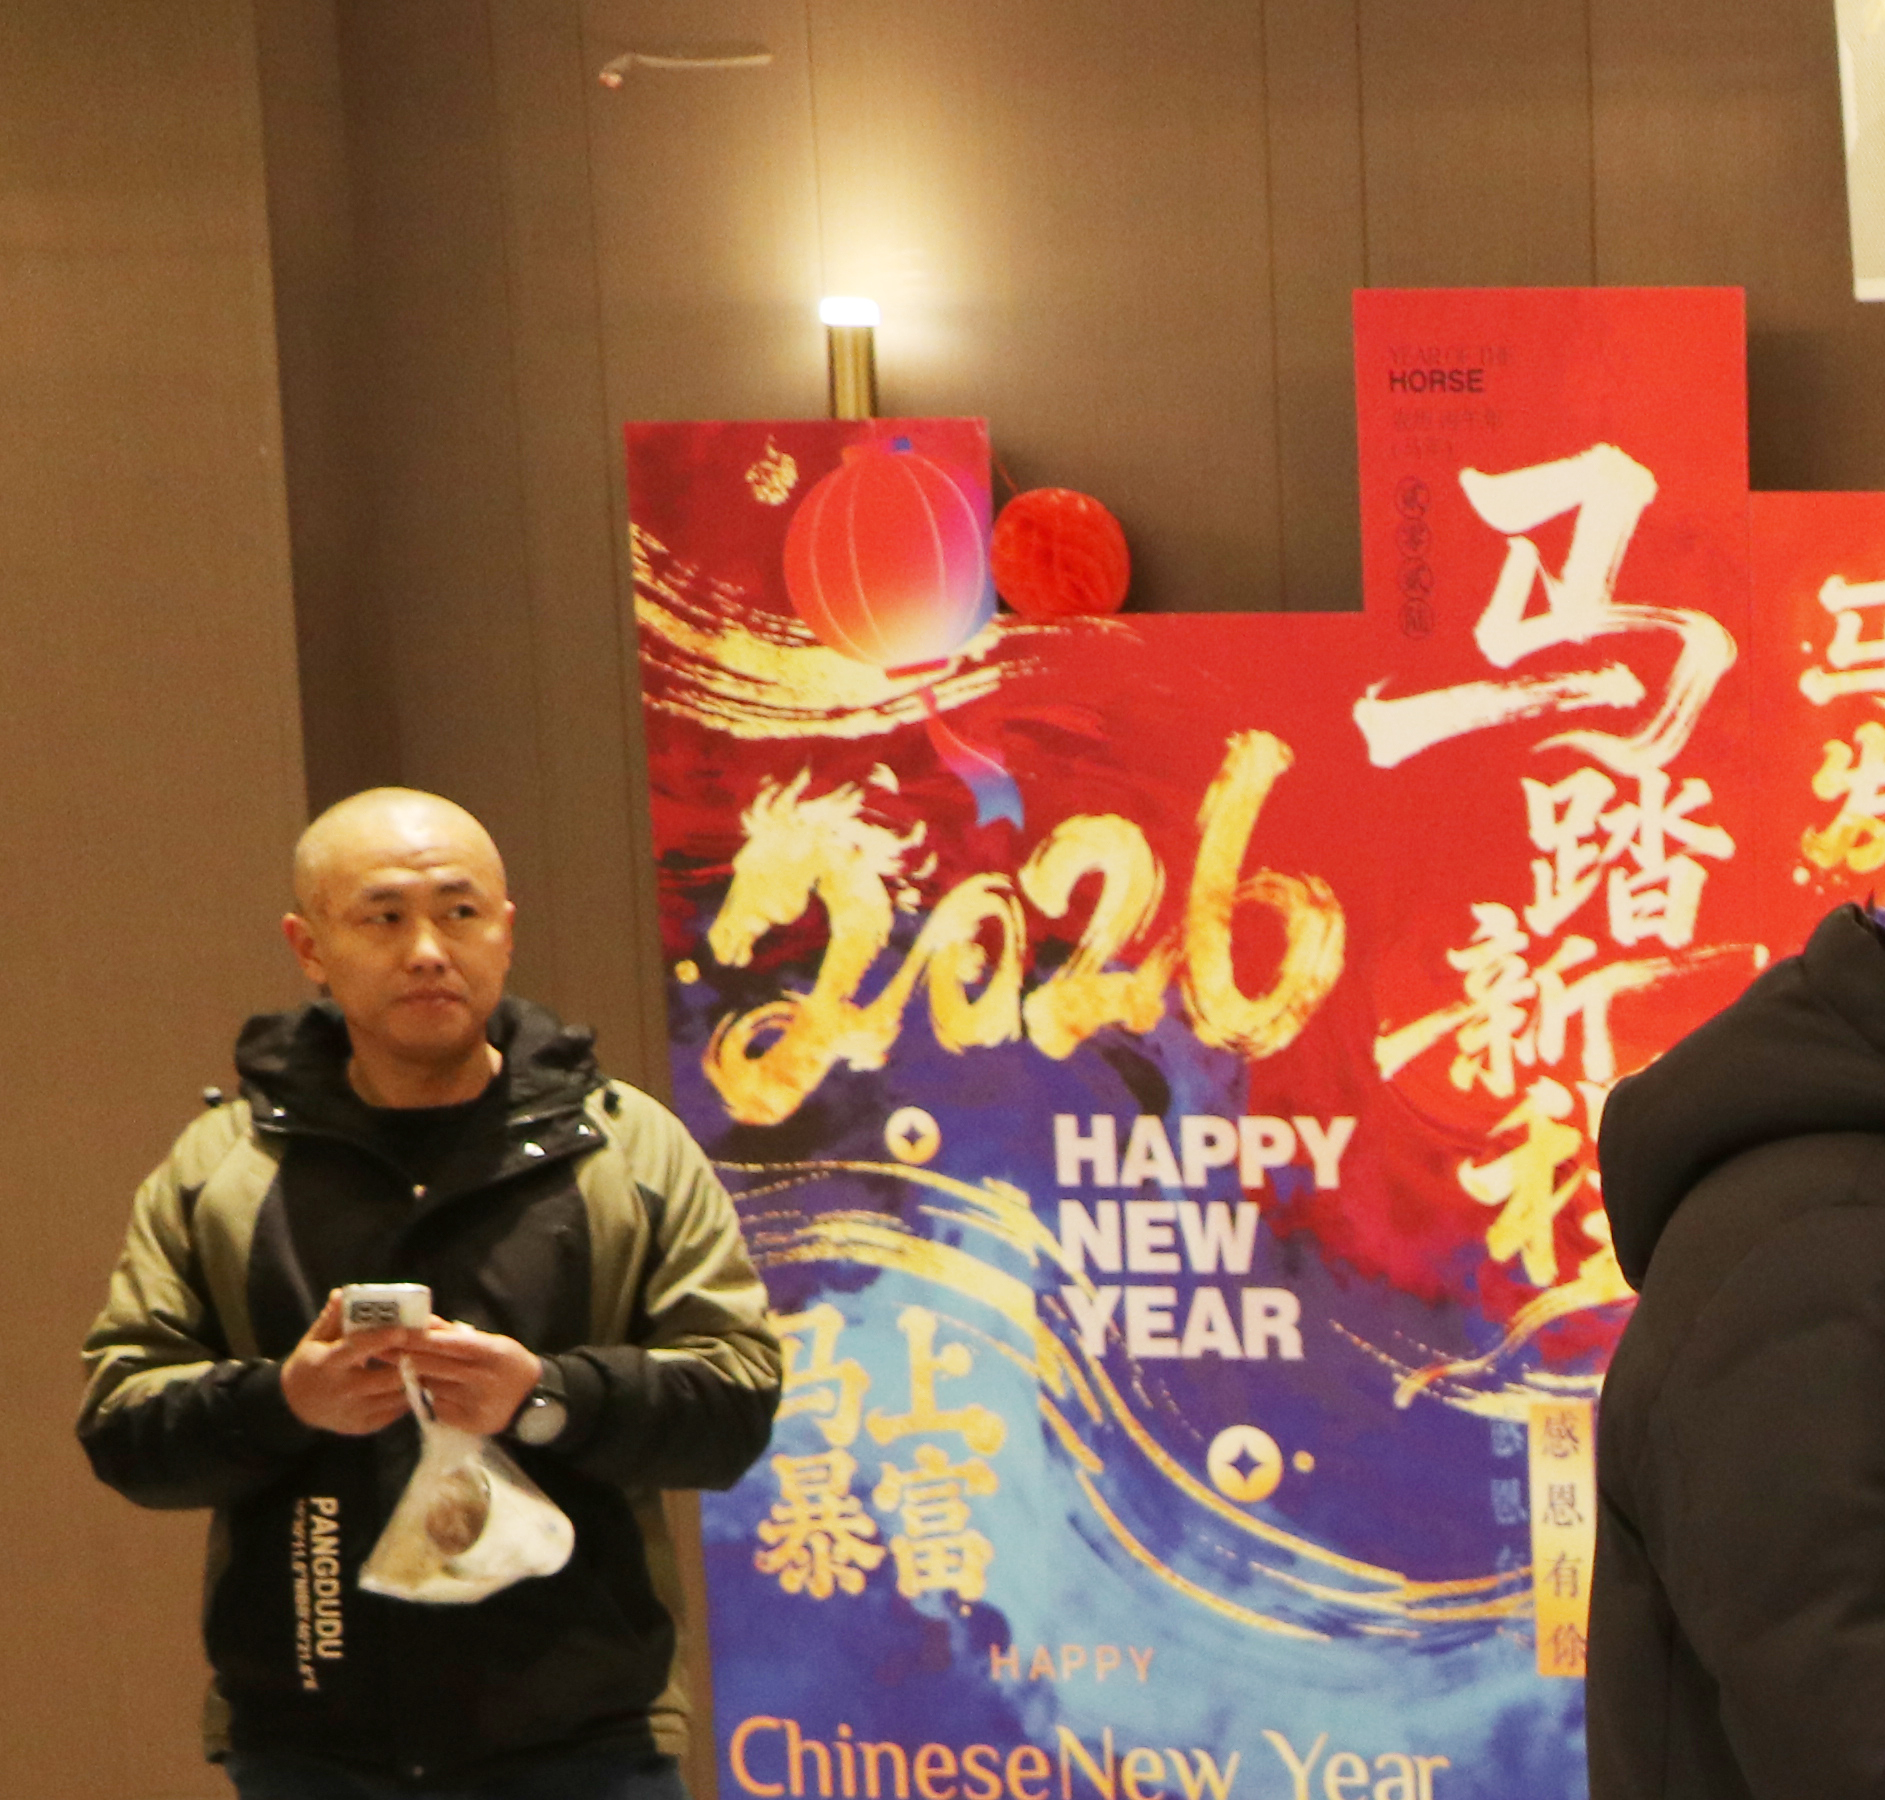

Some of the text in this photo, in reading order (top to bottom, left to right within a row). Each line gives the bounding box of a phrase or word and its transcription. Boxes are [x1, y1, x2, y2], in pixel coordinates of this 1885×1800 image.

[1389, 368, 1484, 394] HORSE
[702, 728, 1346, 1126] 2026
[1052, 1114, 1356, 1192] HAPPY
[1058, 1202, 1260, 1276] NEW
[1058, 1285, 1306, 1362] YEAR
[764, 1302, 1008, 1456] 马上
[753, 1446, 1000, 1601] 暴富
[988, 1642, 1157, 1684] HAPPY
